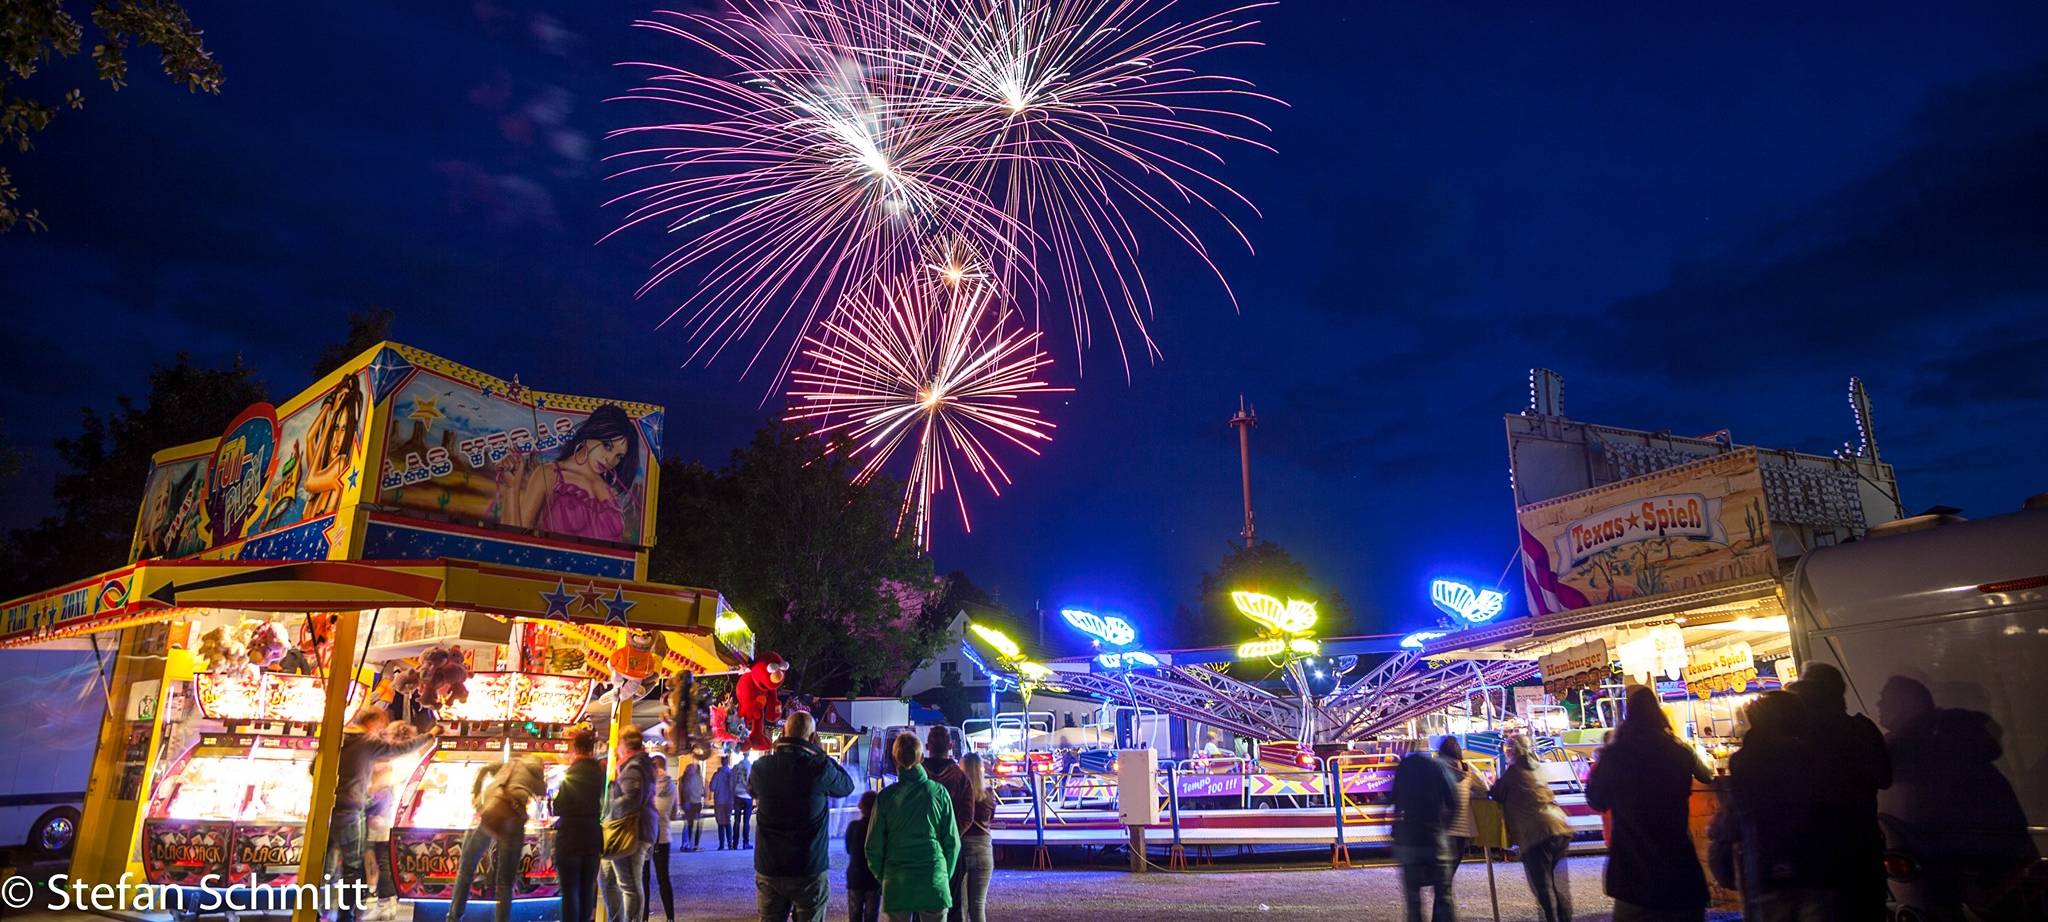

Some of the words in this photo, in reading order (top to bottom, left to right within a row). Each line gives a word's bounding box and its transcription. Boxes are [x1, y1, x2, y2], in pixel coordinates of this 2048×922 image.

[383, 446, 452, 490] LAS
[460, 417, 577, 468] VEGAS
[223, 444, 265, 537] PLAY
[1572, 515, 1625, 554] Texas
[1641, 498, 1701, 537] Spieß
[8, 604, 30, 633] PLAY
[61, 588, 88, 621] ZONE
[1546, 652, 1602, 677] Hamburger
[1687, 661, 1712, 676] Texas
[1719, 650, 1747, 669] Spieß
[1183, 777, 1211, 794] Tempo
[1208, 782, 1223, 795] 100
[156, 844, 190, 862] BLACK
[193, 845, 222, 863] JACK
[241, 846, 287, 863] BLACK
[406, 854, 448, 873] BLACK
